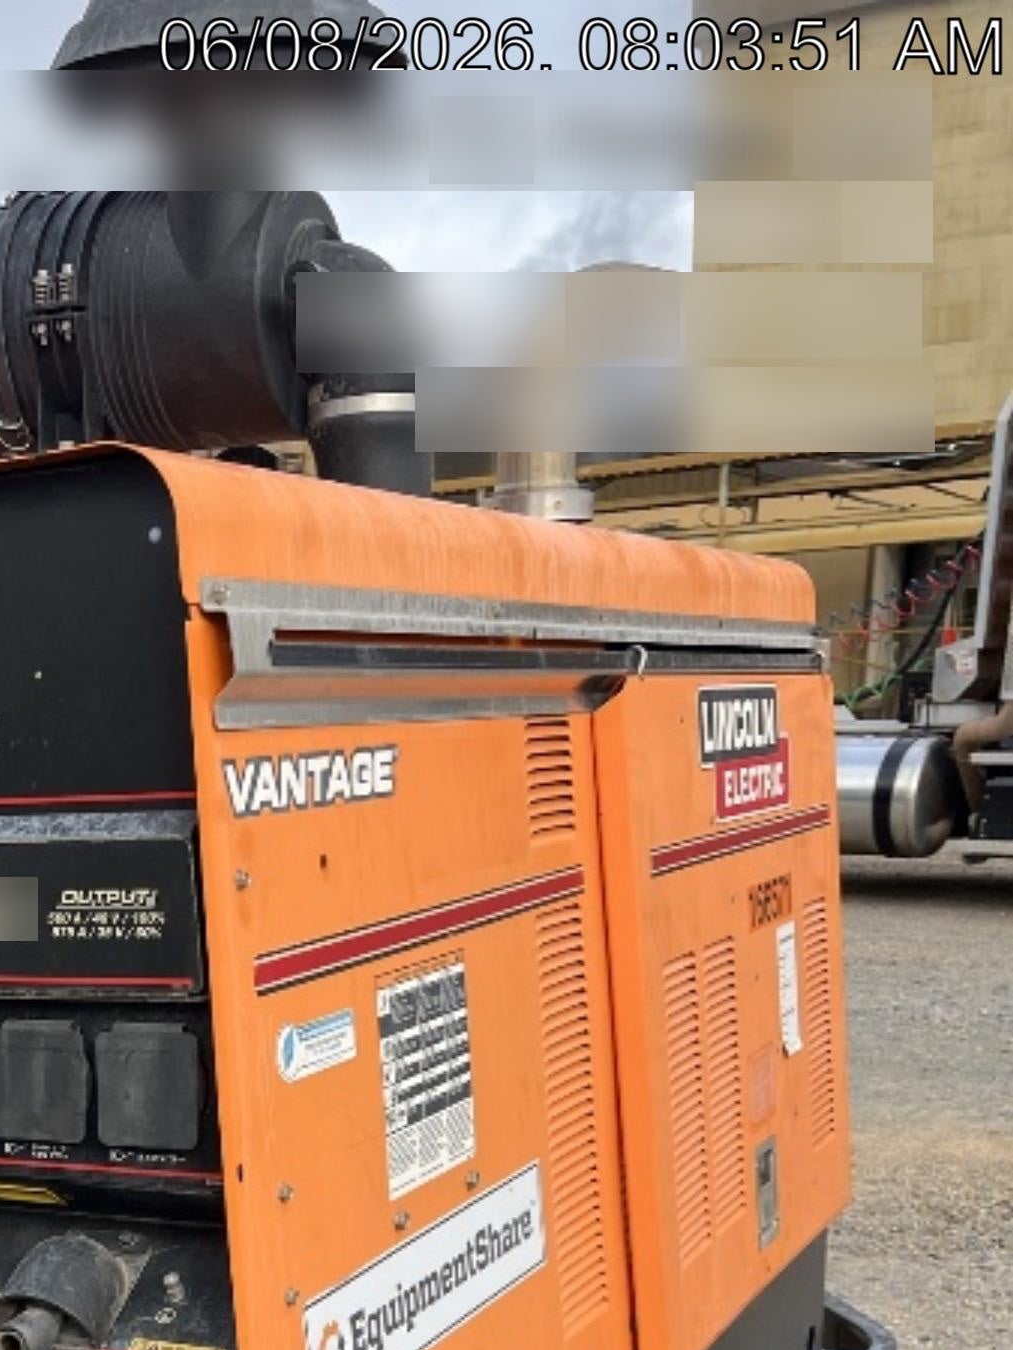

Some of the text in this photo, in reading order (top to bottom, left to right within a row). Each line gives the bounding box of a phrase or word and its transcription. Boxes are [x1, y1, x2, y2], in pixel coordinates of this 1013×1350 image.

[701, 698, 777, 754] LINCOLN
[223, 747, 396, 816] VANTAGE
[724, 760, 786, 807] ELECTRIC
[61, 889, 151, 905] OUTPUT
